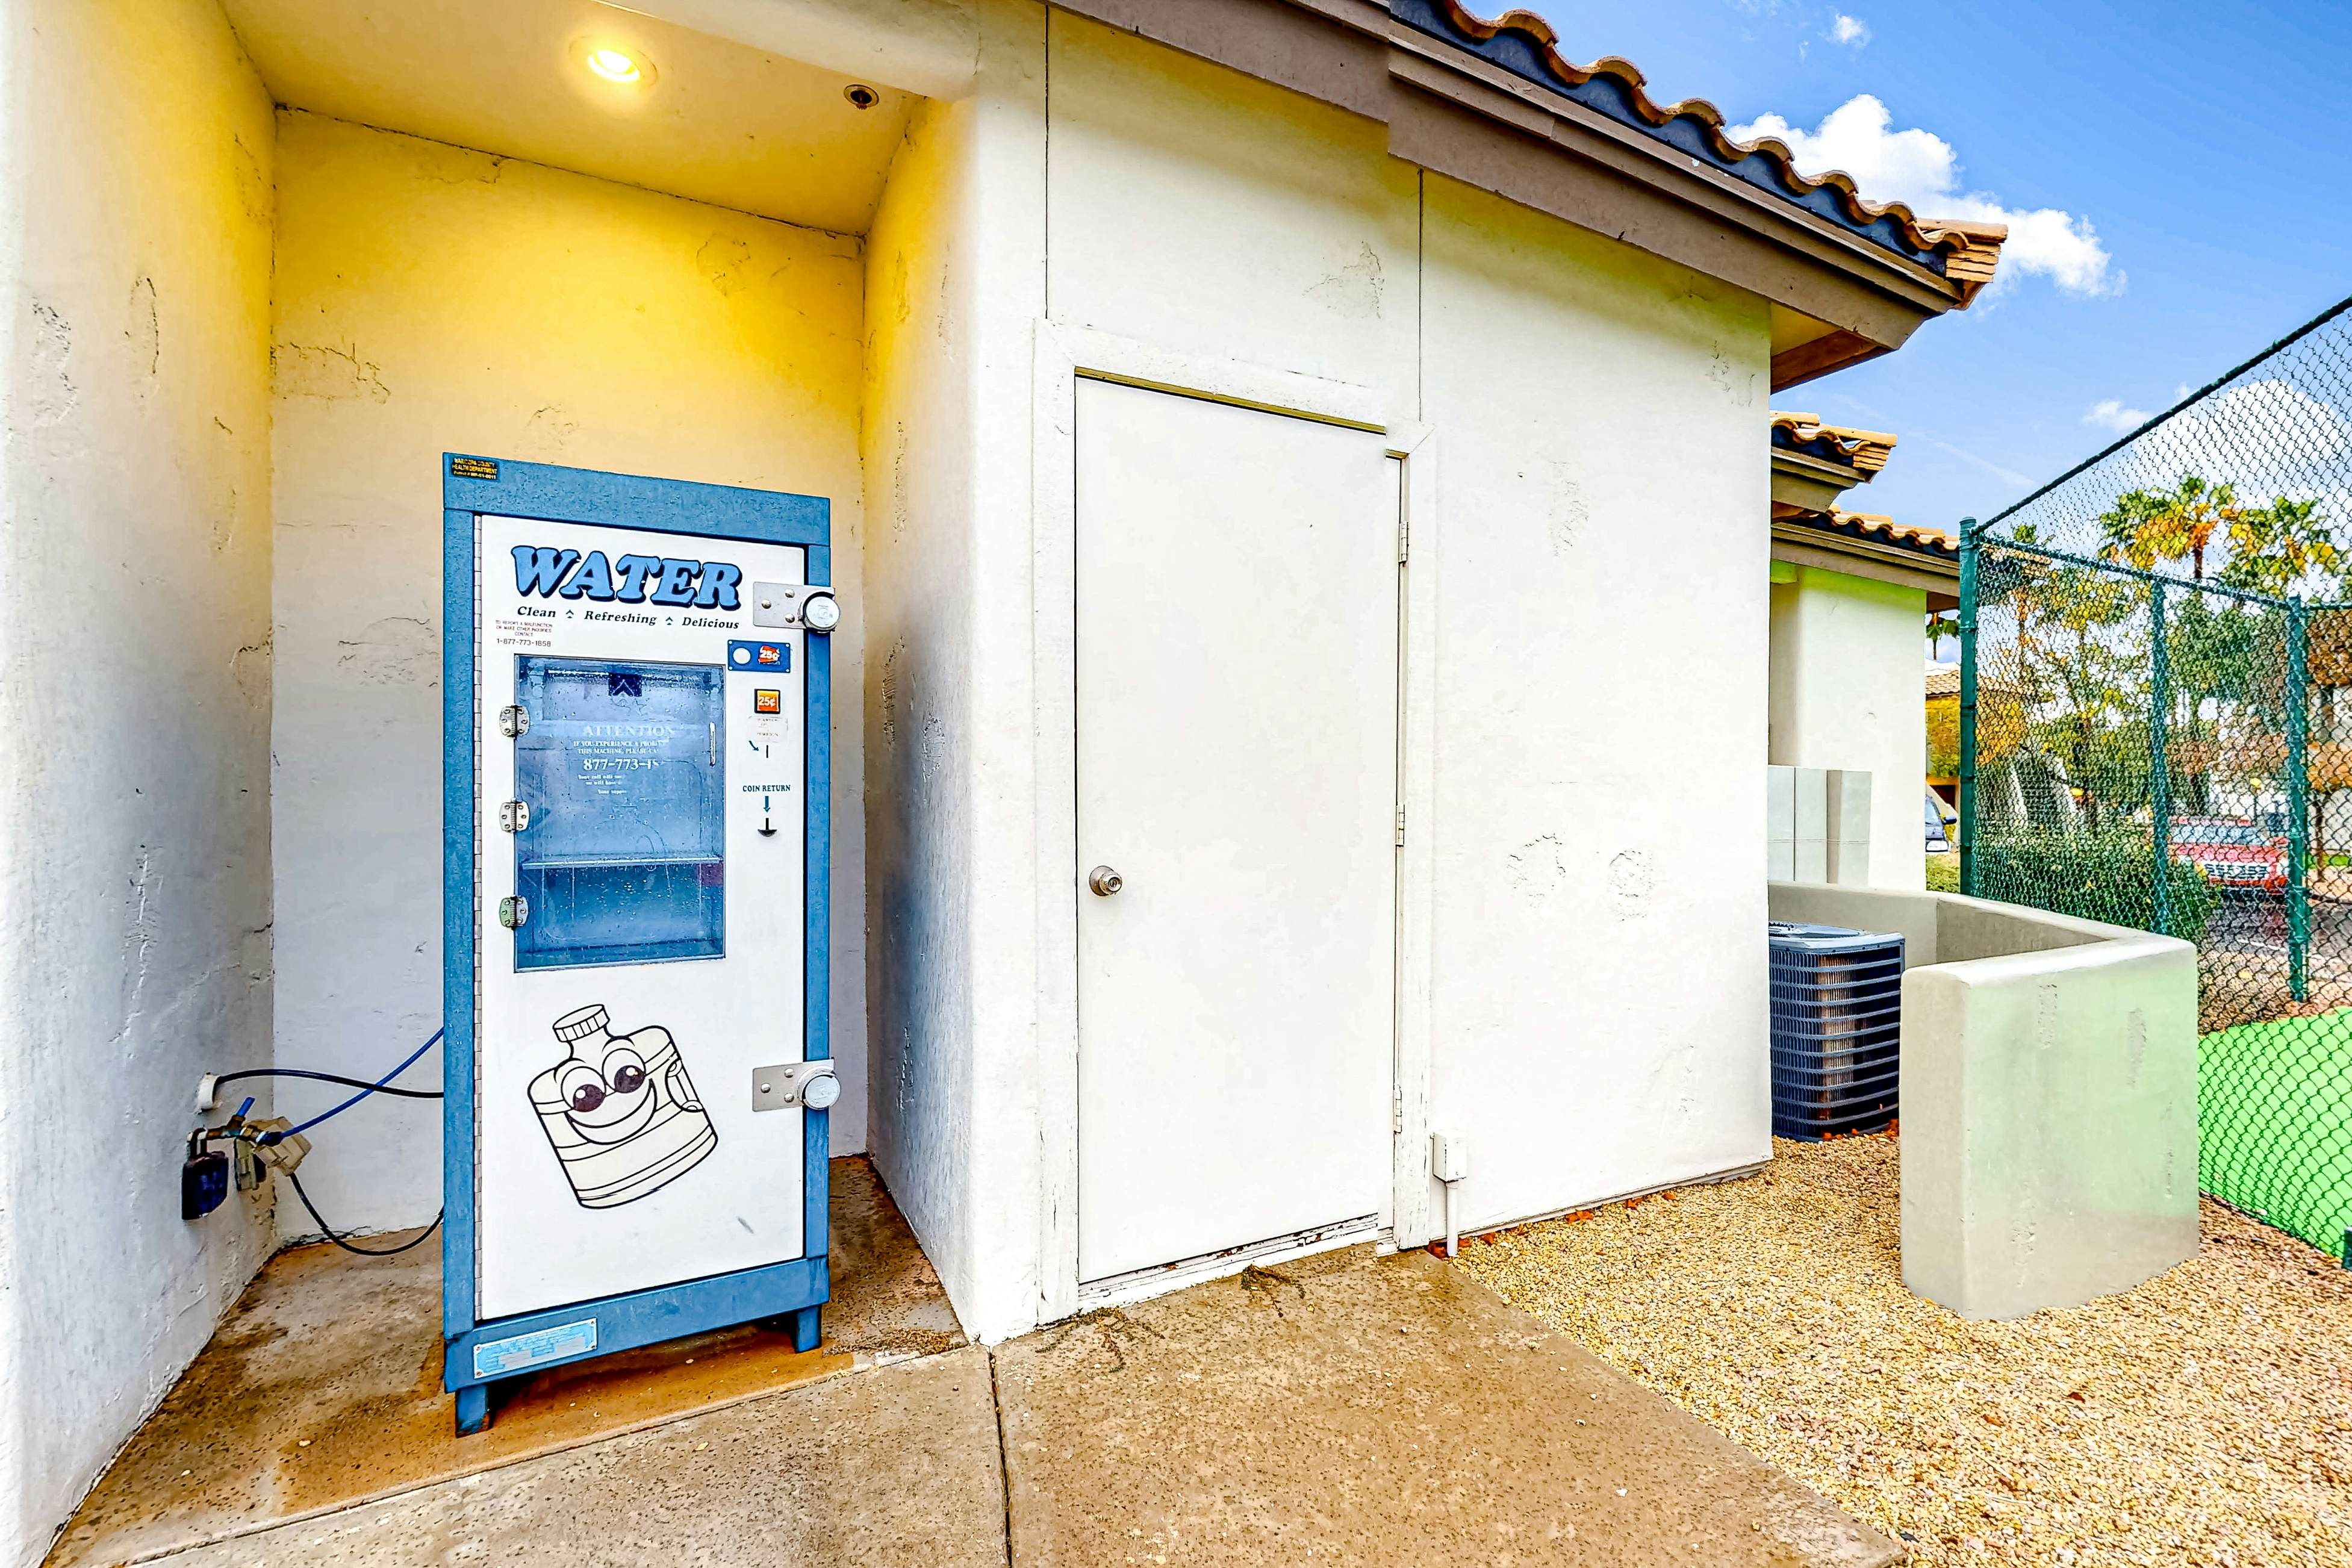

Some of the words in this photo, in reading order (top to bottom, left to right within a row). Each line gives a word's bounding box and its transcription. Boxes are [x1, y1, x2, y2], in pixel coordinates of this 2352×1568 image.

[470, 465, 497, 474] DEPARTMENT
[511, 545, 742, 611] WATER
[517, 606, 556, 618] Clean
[584, 611, 657, 626] Refreshing
[682, 617, 739, 629] Delicious
[497, 638, 551, 647] 1-877-773-1858
[759, 696, 776, 708] 25¢
[583, 724, 676, 738] ATTENTION
